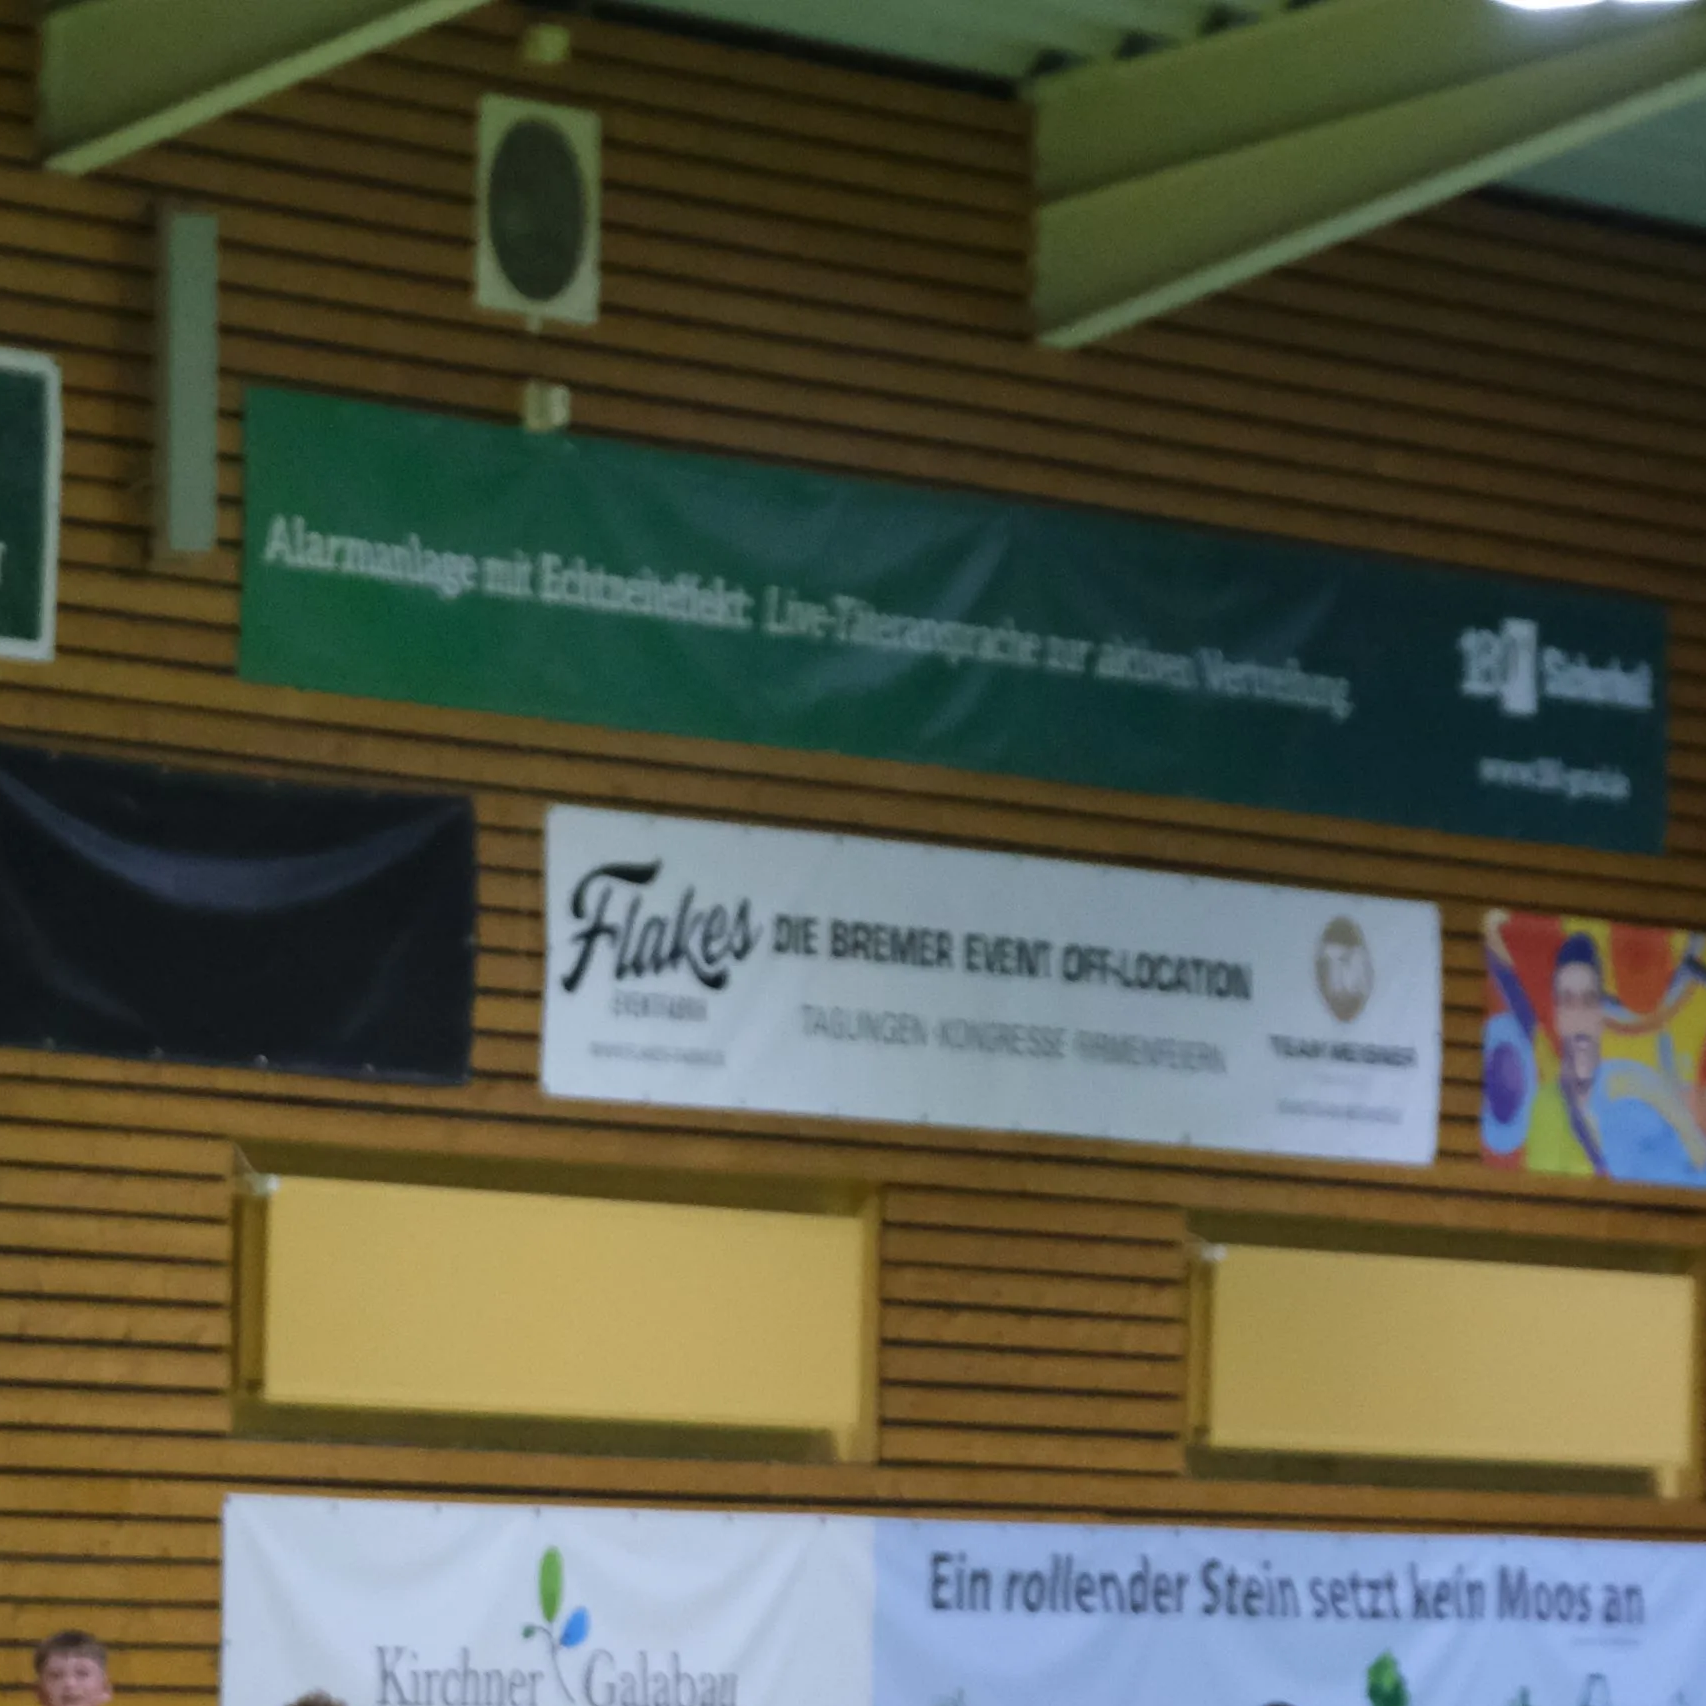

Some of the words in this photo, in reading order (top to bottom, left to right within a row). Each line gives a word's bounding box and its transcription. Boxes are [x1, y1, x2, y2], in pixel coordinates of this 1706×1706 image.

[264, 513, 477, 600] Alarmanlage
[482, 549, 534, 598] mit
[561, 860, 761, 993] Flakes
[772, 912, 818, 956] DIE
[830, 918, 955, 970] BREMER
[962, 932, 1051, 979] EVENT
[1062, 942, 1253, 1001] OFF-LOCATION
[800, 1003, 927, 1047] TAGUNGEN
[930, 1551, 991, 1612] Ein
[1005, 1553, 1189, 1616] rollender
[1200, 1557, 1300, 1619] Stein
[1310, 1568, 1402, 1620] setzt
[1410, 1560, 1487, 1621] kein
[1497, 1565, 1591, 1624] Moos
[1602, 1579, 1646, 1626] an
